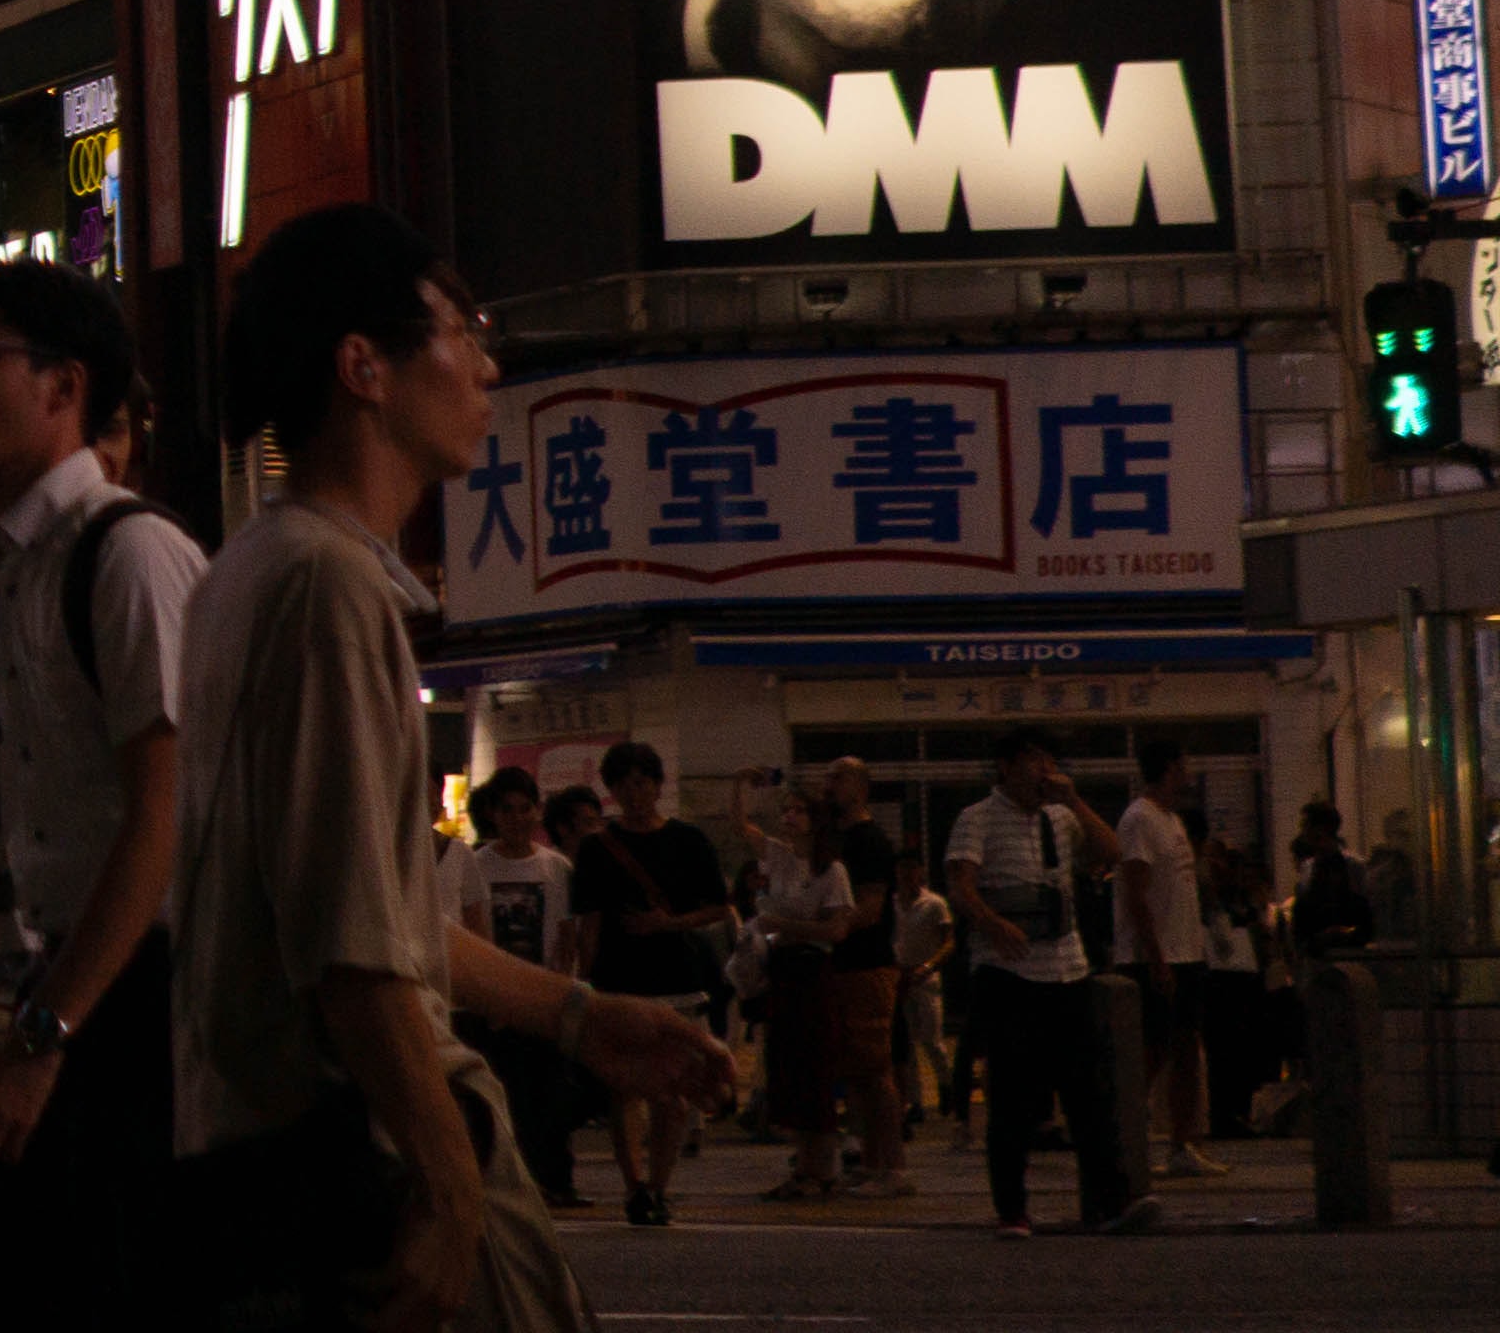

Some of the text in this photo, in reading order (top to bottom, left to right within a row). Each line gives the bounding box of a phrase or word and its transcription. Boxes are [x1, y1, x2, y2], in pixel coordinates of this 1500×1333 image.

[655, 59, 1218, 243] DMM
[467, 395, 1176, 573] 大盛堂書店
[1037, 550, 1215, 577] BOOKS TAISEIDO
[925, 642, 1081, 662] TAISEIDO
